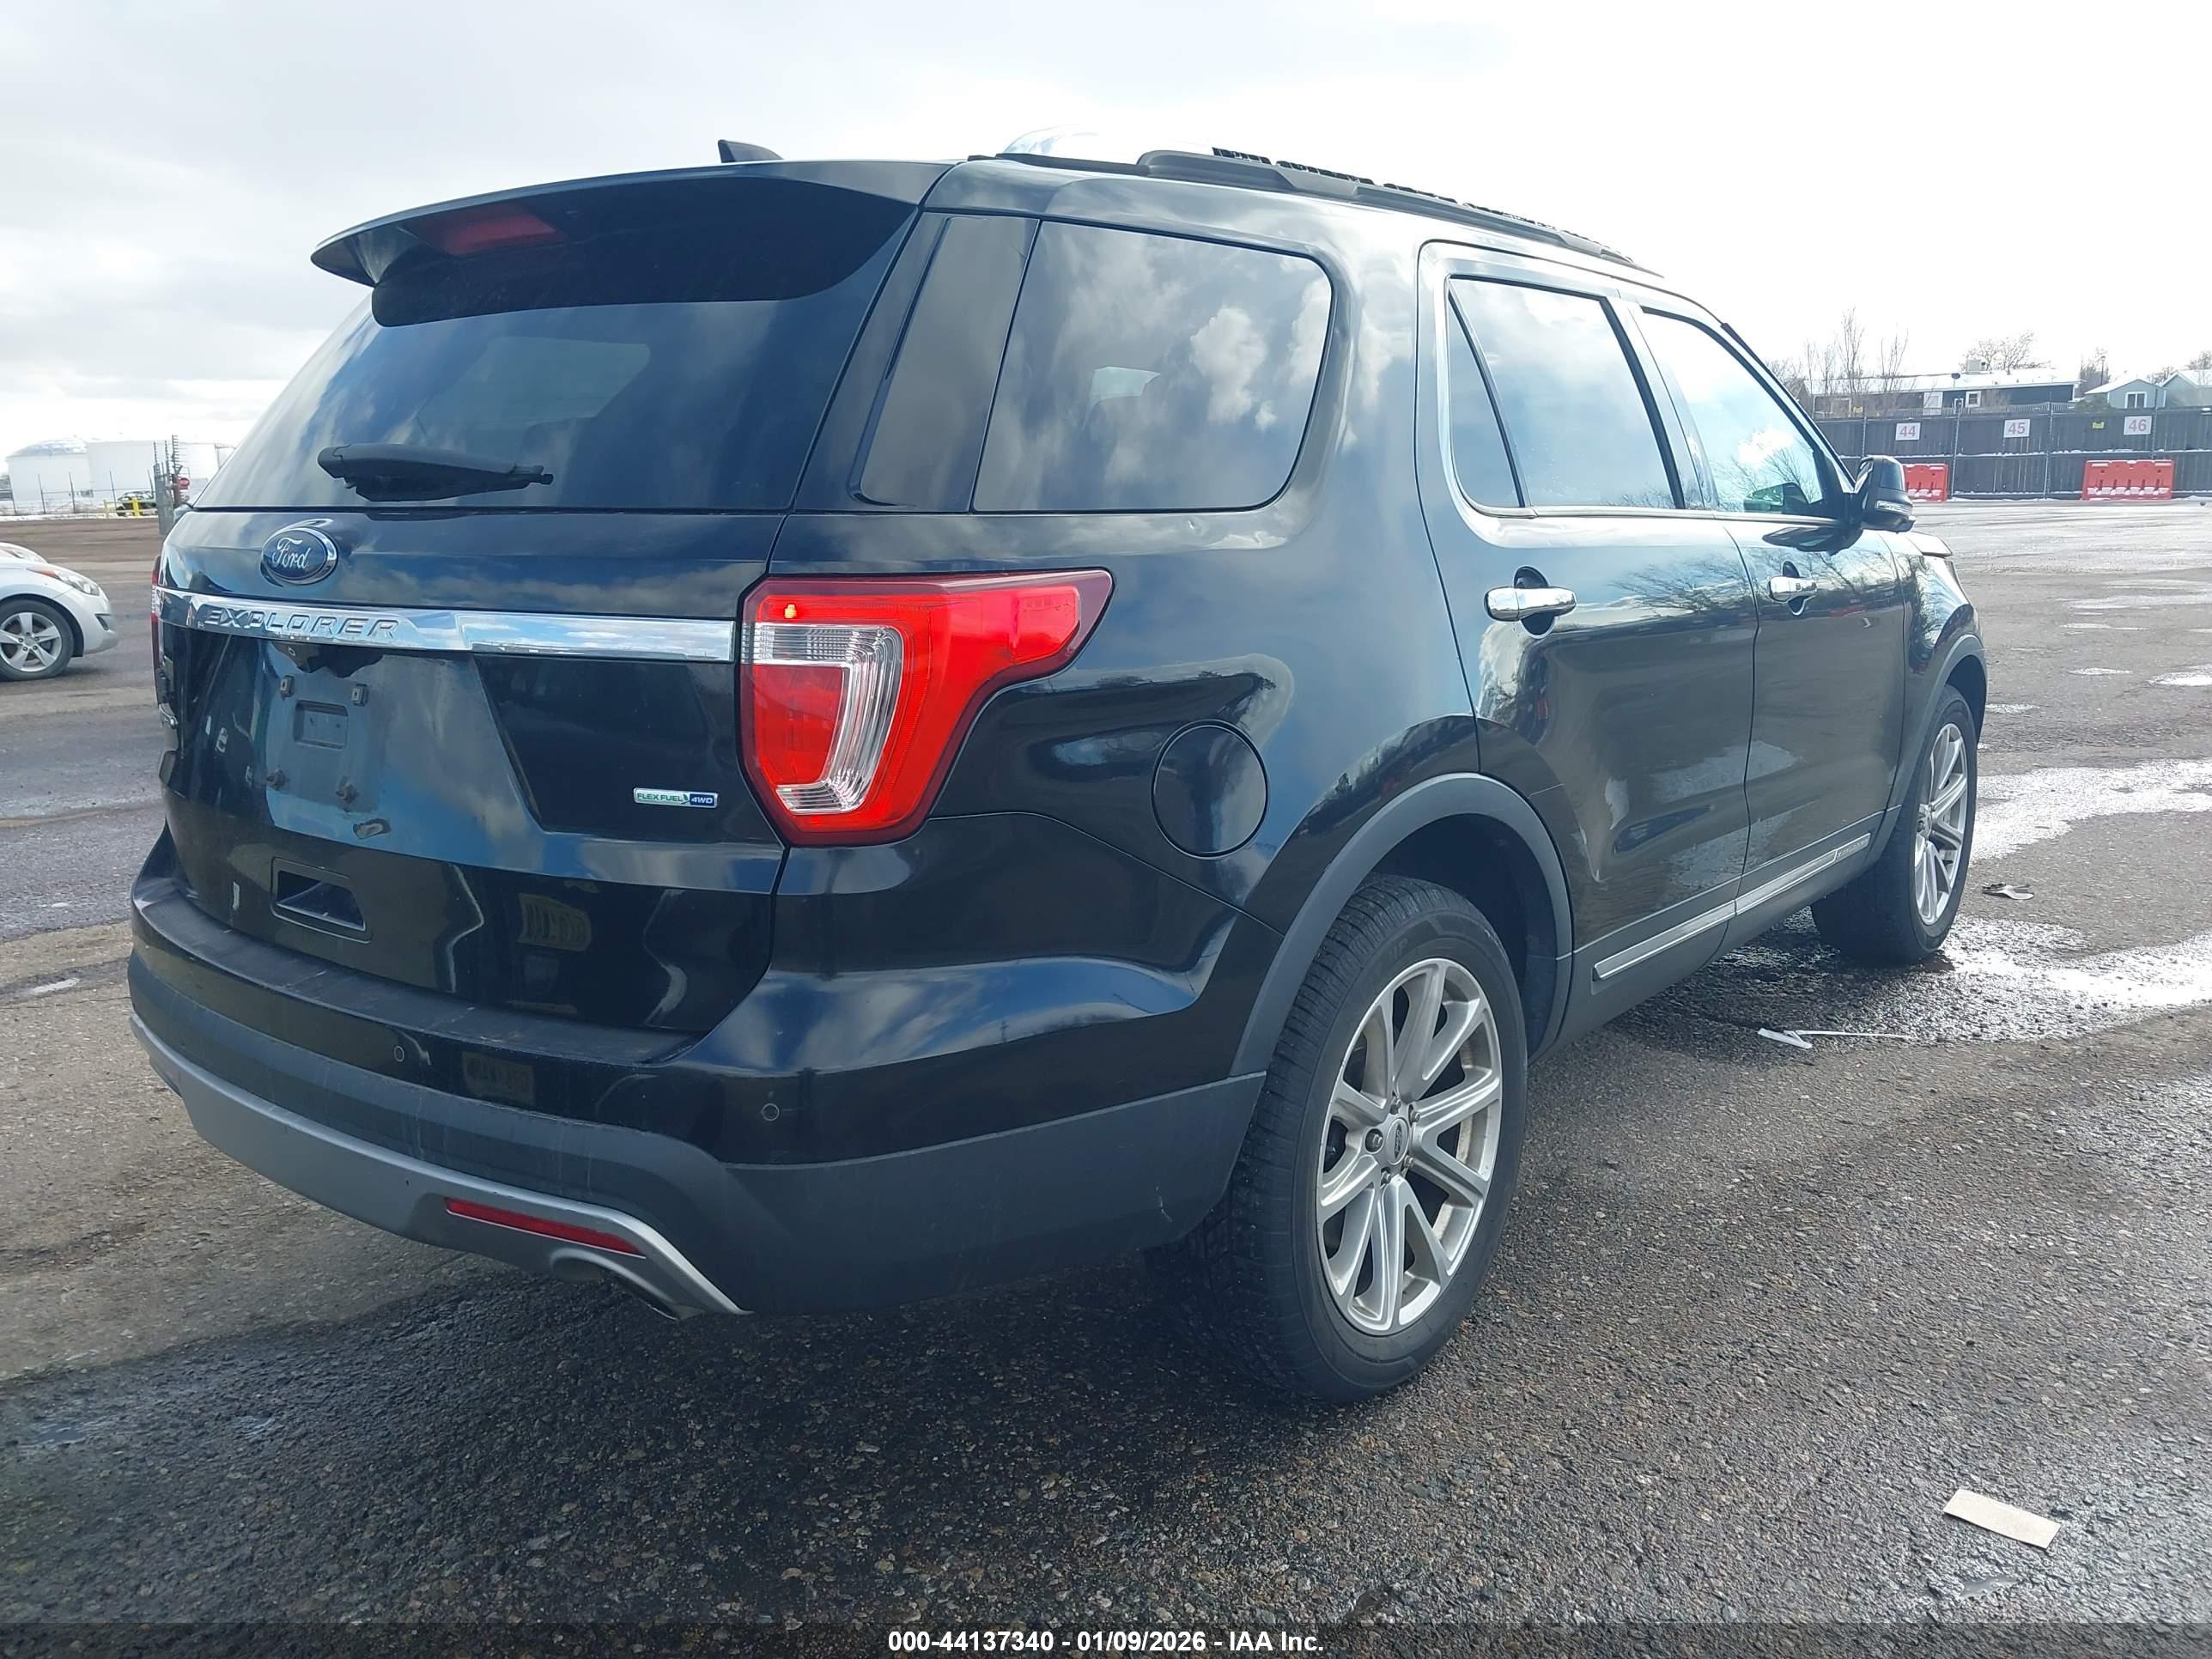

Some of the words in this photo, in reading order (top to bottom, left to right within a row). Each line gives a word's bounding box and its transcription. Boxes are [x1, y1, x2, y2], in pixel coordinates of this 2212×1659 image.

[1899, 426, 1917, 437] 44
[2008, 422, 2026, 434] 45
[2129, 419, 2147, 432] 46
[271, 537, 312, 569] Ford
[204, 608, 399, 638] EXPLORER
[636, 793, 659, 801] FLEX
